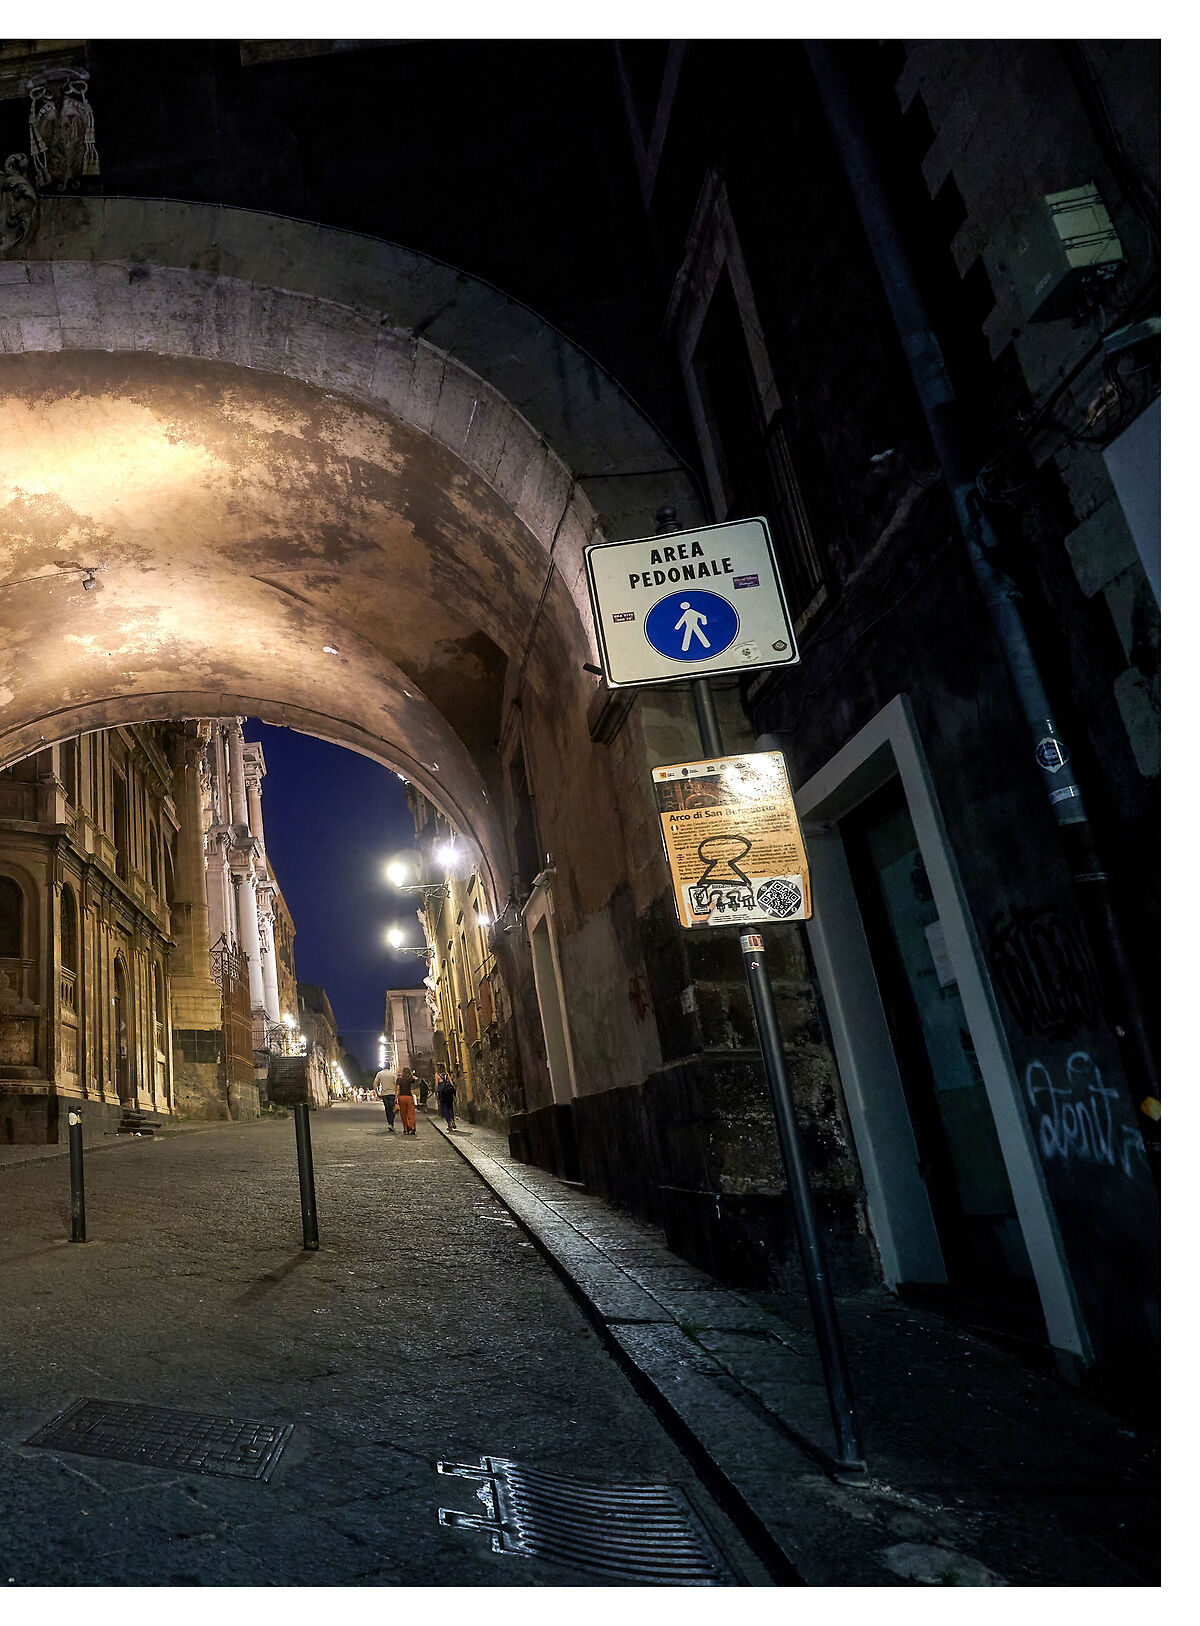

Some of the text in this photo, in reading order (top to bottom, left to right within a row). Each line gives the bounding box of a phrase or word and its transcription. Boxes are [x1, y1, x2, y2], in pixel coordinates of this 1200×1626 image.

[650, 541, 705, 566] AREA
[628, 557, 735, 590] PEDONALE
[669, 804, 777, 822] Arco di San Benetto
